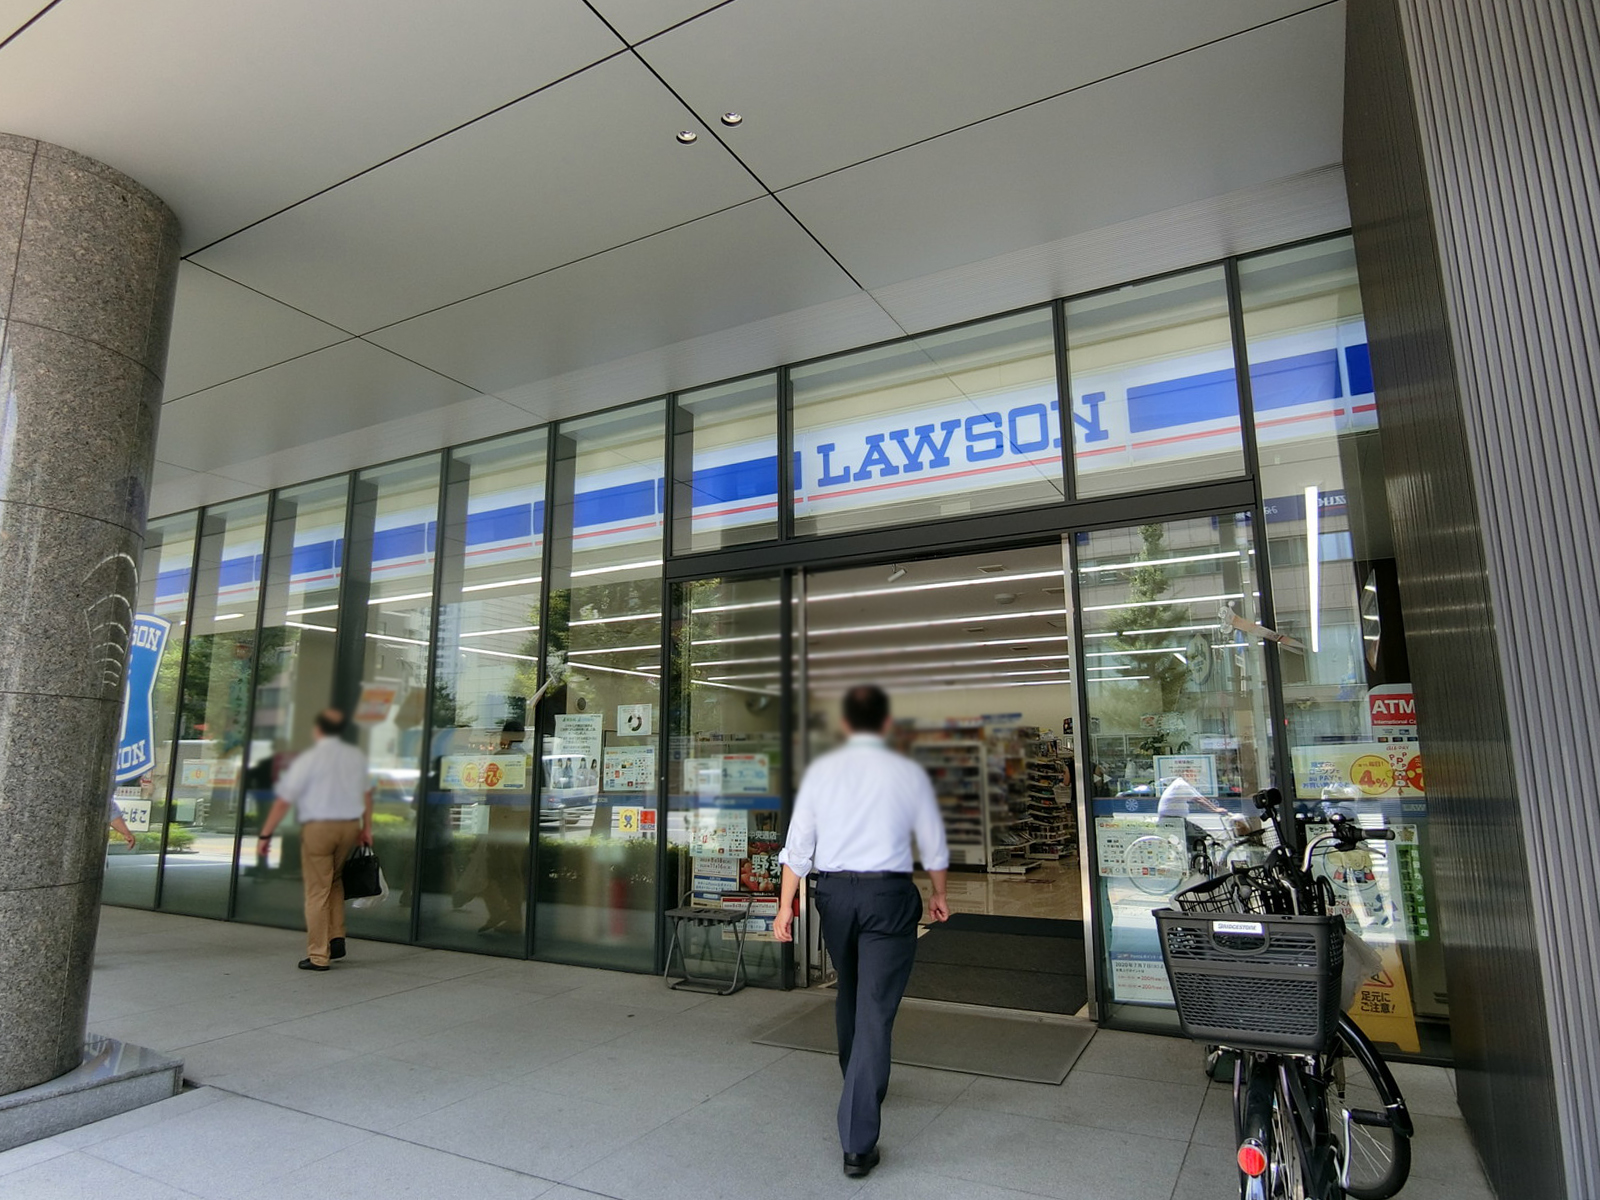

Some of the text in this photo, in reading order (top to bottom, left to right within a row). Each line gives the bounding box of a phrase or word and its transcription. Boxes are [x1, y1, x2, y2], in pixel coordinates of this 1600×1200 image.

[816, 391, 1110, 489] LAWSON
[1371, 699, 1416, 714] ATM
[1359, 769, 1388, 788] 4%
[1218, 923, 1257, 931] BRIDGESTONE
[1361, 990, 1392, 1002] 足元に
